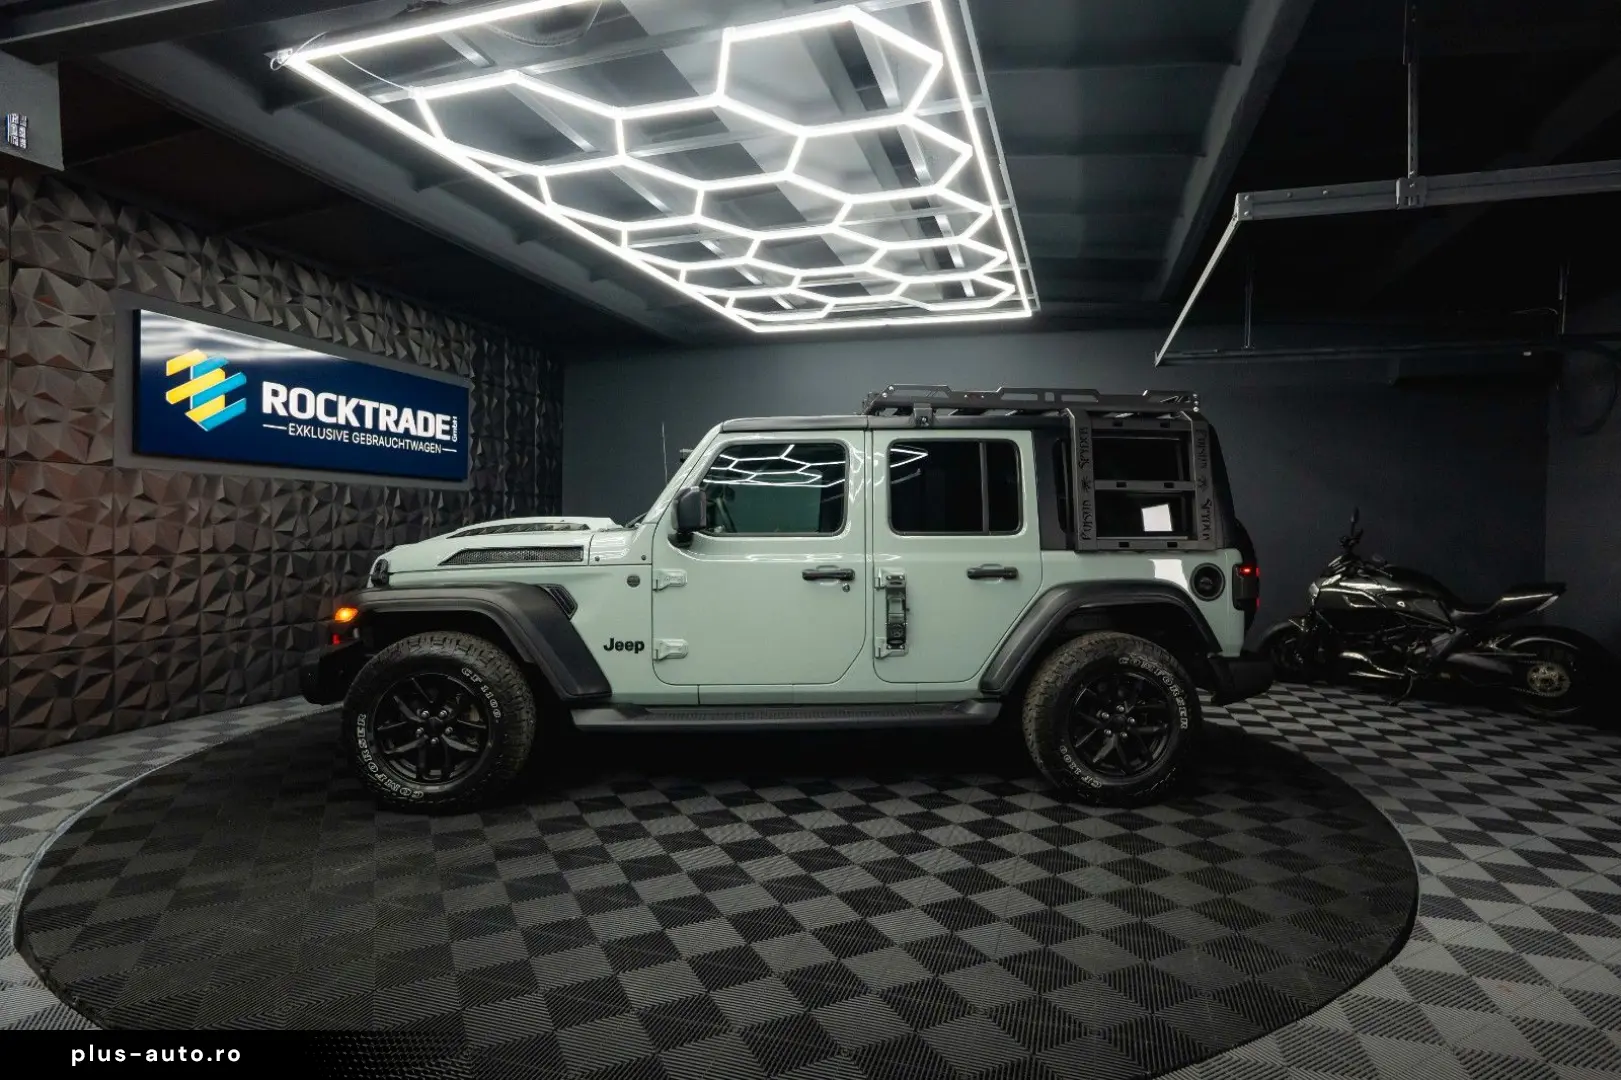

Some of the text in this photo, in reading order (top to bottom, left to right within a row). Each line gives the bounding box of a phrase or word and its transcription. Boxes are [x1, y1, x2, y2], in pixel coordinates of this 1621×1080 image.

[262, 380, 451, 441] ROCKTRADE
[288, 423, 442, 454] EXKLUSIVE GEBRAUCHTWAGEN
[603, 637, 645, 654] Jeep
